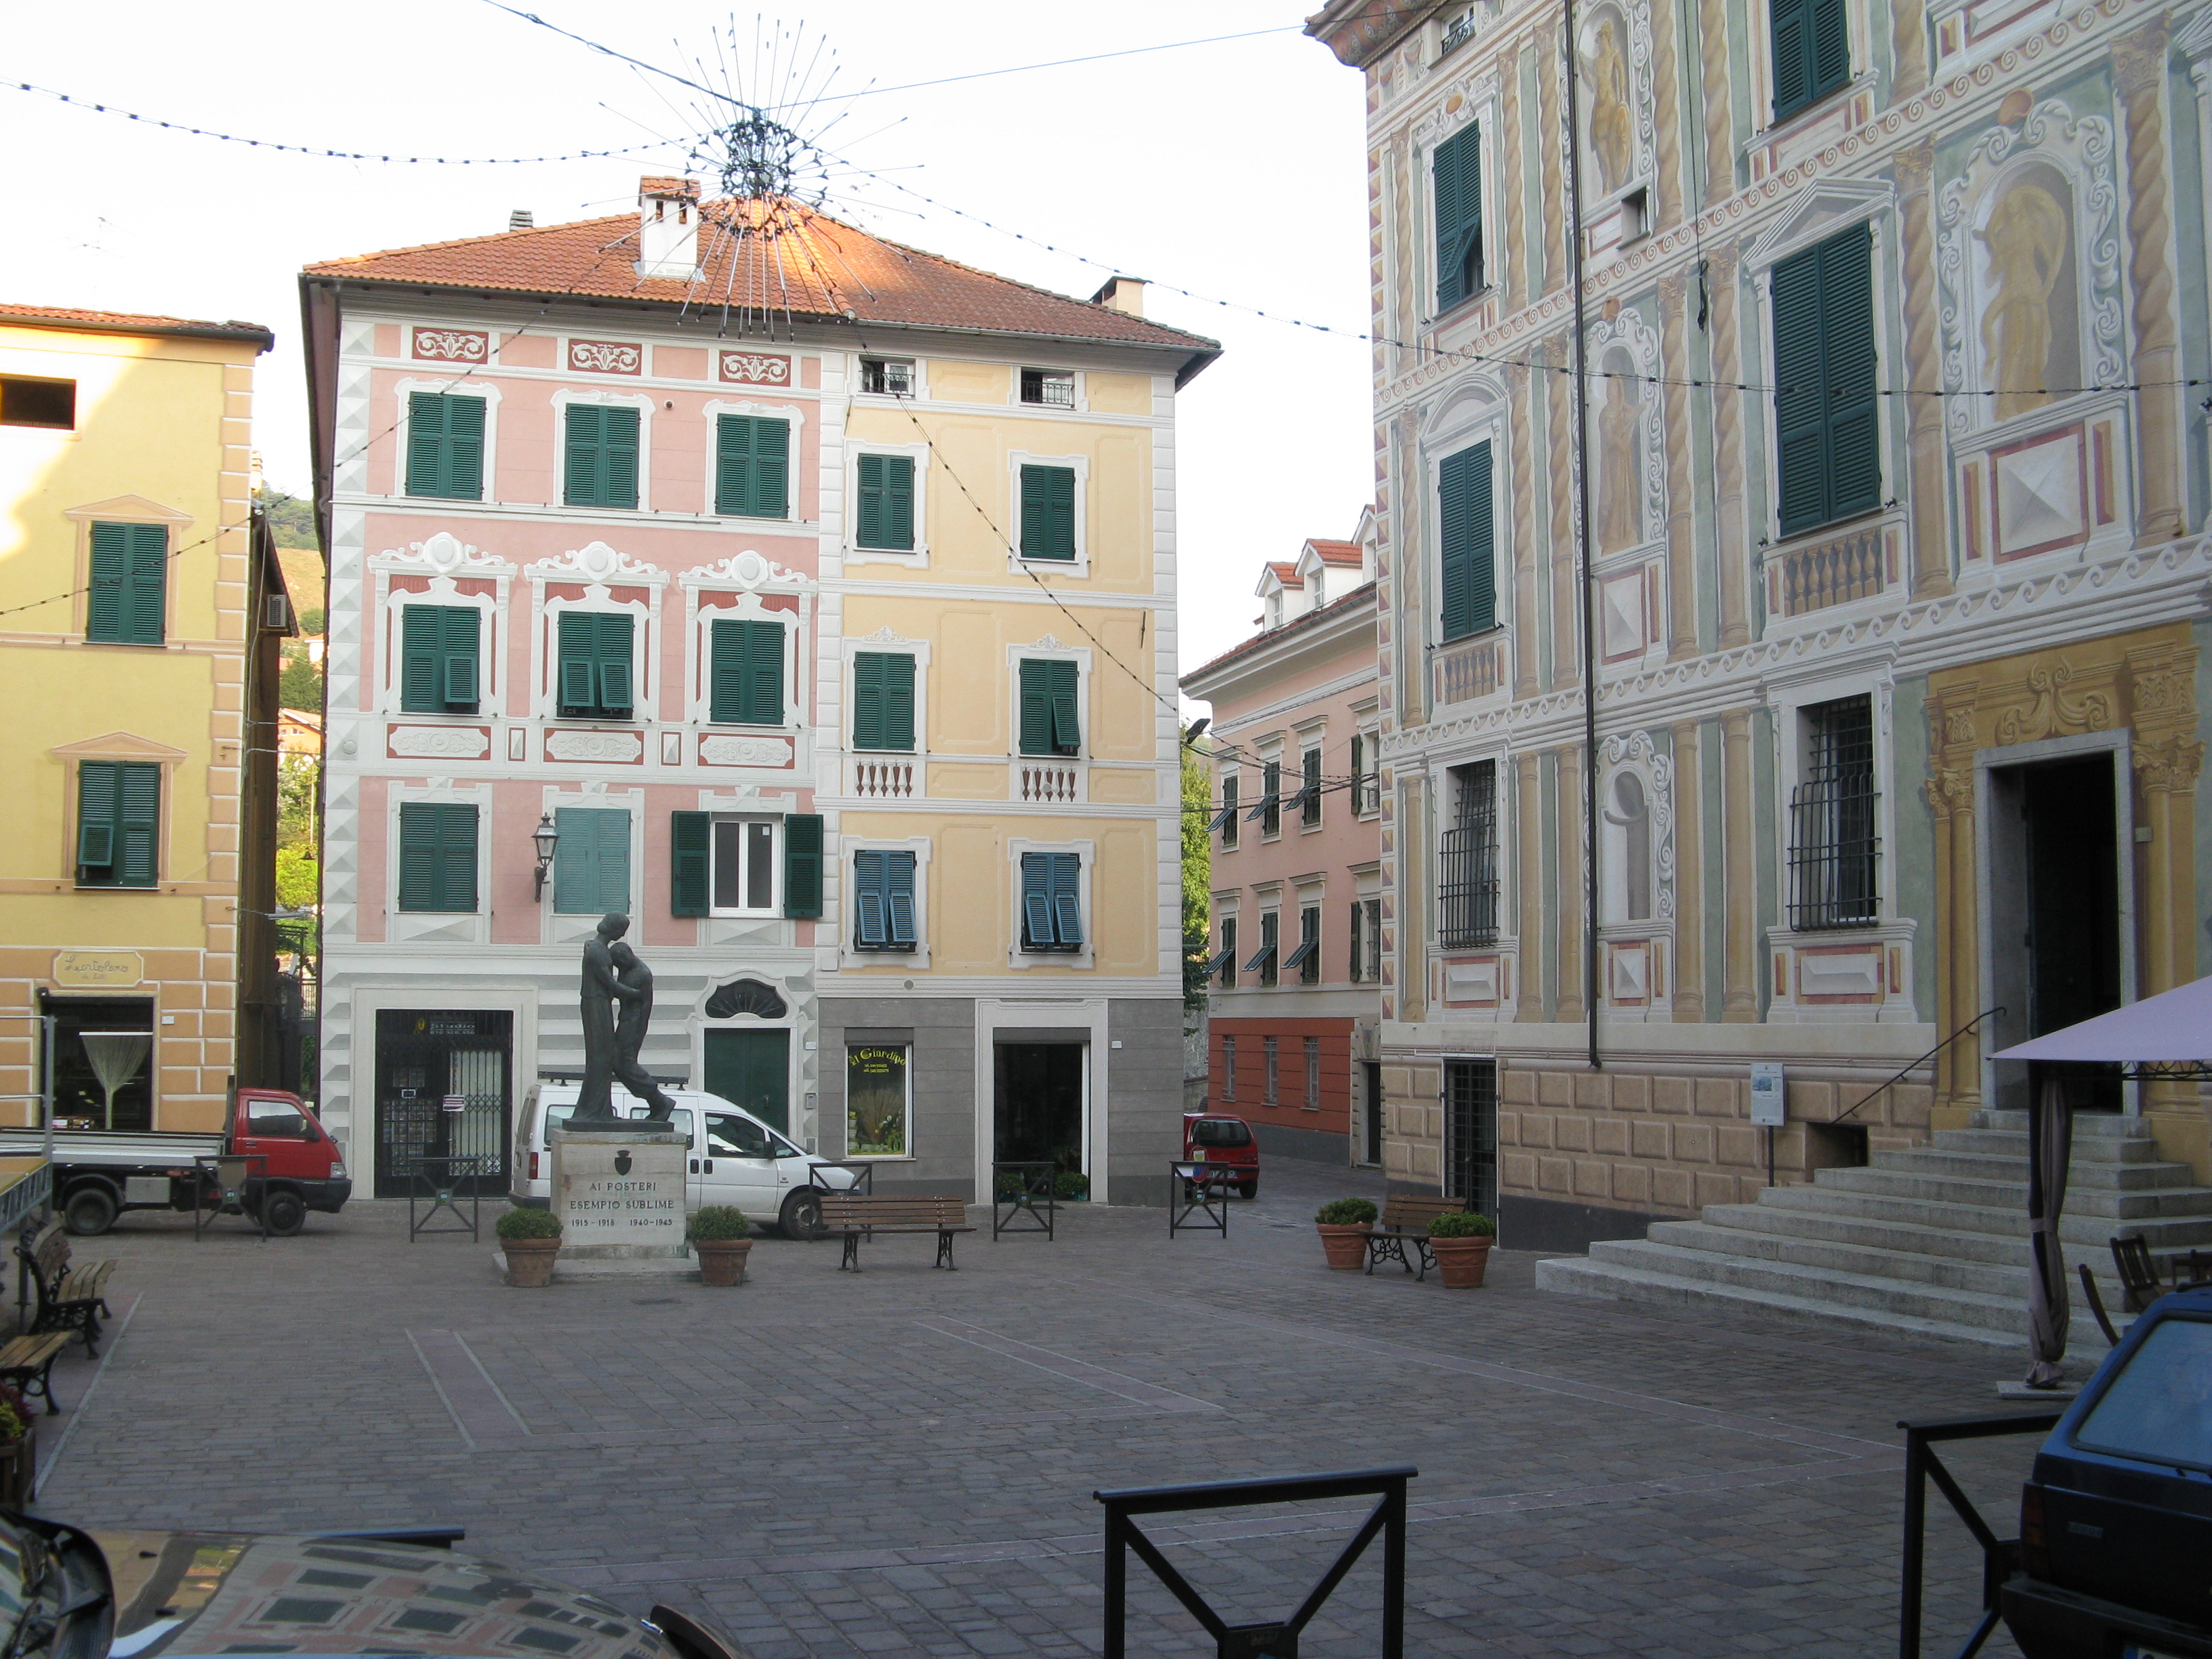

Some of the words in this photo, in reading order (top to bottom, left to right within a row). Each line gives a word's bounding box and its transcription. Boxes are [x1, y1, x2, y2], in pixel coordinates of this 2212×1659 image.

[589, 1183, 601, 1191] AI
[607, 1182, 657, 1191] POSTERI
[570, 1200, 621, 1210] ESEMPIO
[626, 1200, 675, 1210] SUBLIME
